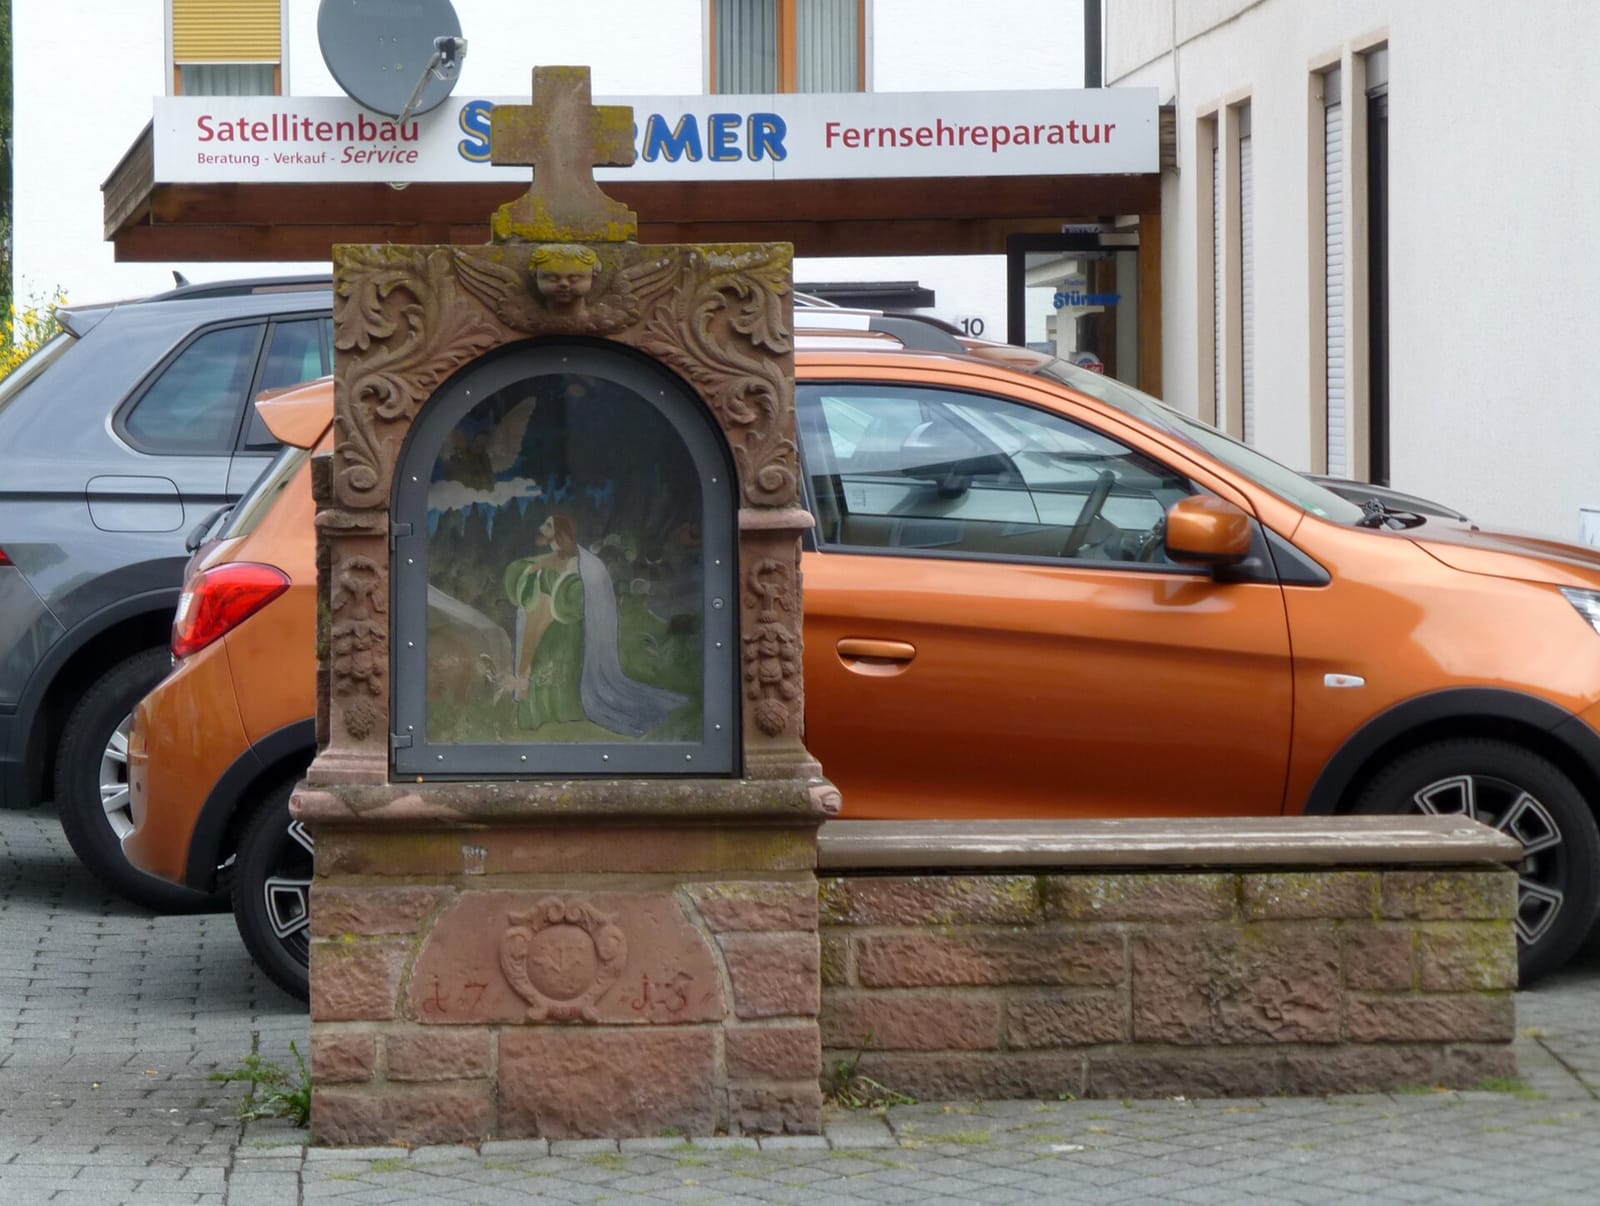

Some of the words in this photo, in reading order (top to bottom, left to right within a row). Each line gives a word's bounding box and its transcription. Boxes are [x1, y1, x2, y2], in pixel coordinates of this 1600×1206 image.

[197, 113, 419, 142] Satellitenbau
[458, 99, 788, 164] SMER
[825, 118, 1117, 153] Fernsehreparatur
[197, 152, 260, 166] Beratung
[273, 151, 327, 164] Verkauf
[340, 144, 419, 164] Service
[961, 317, 985, 336] 10
